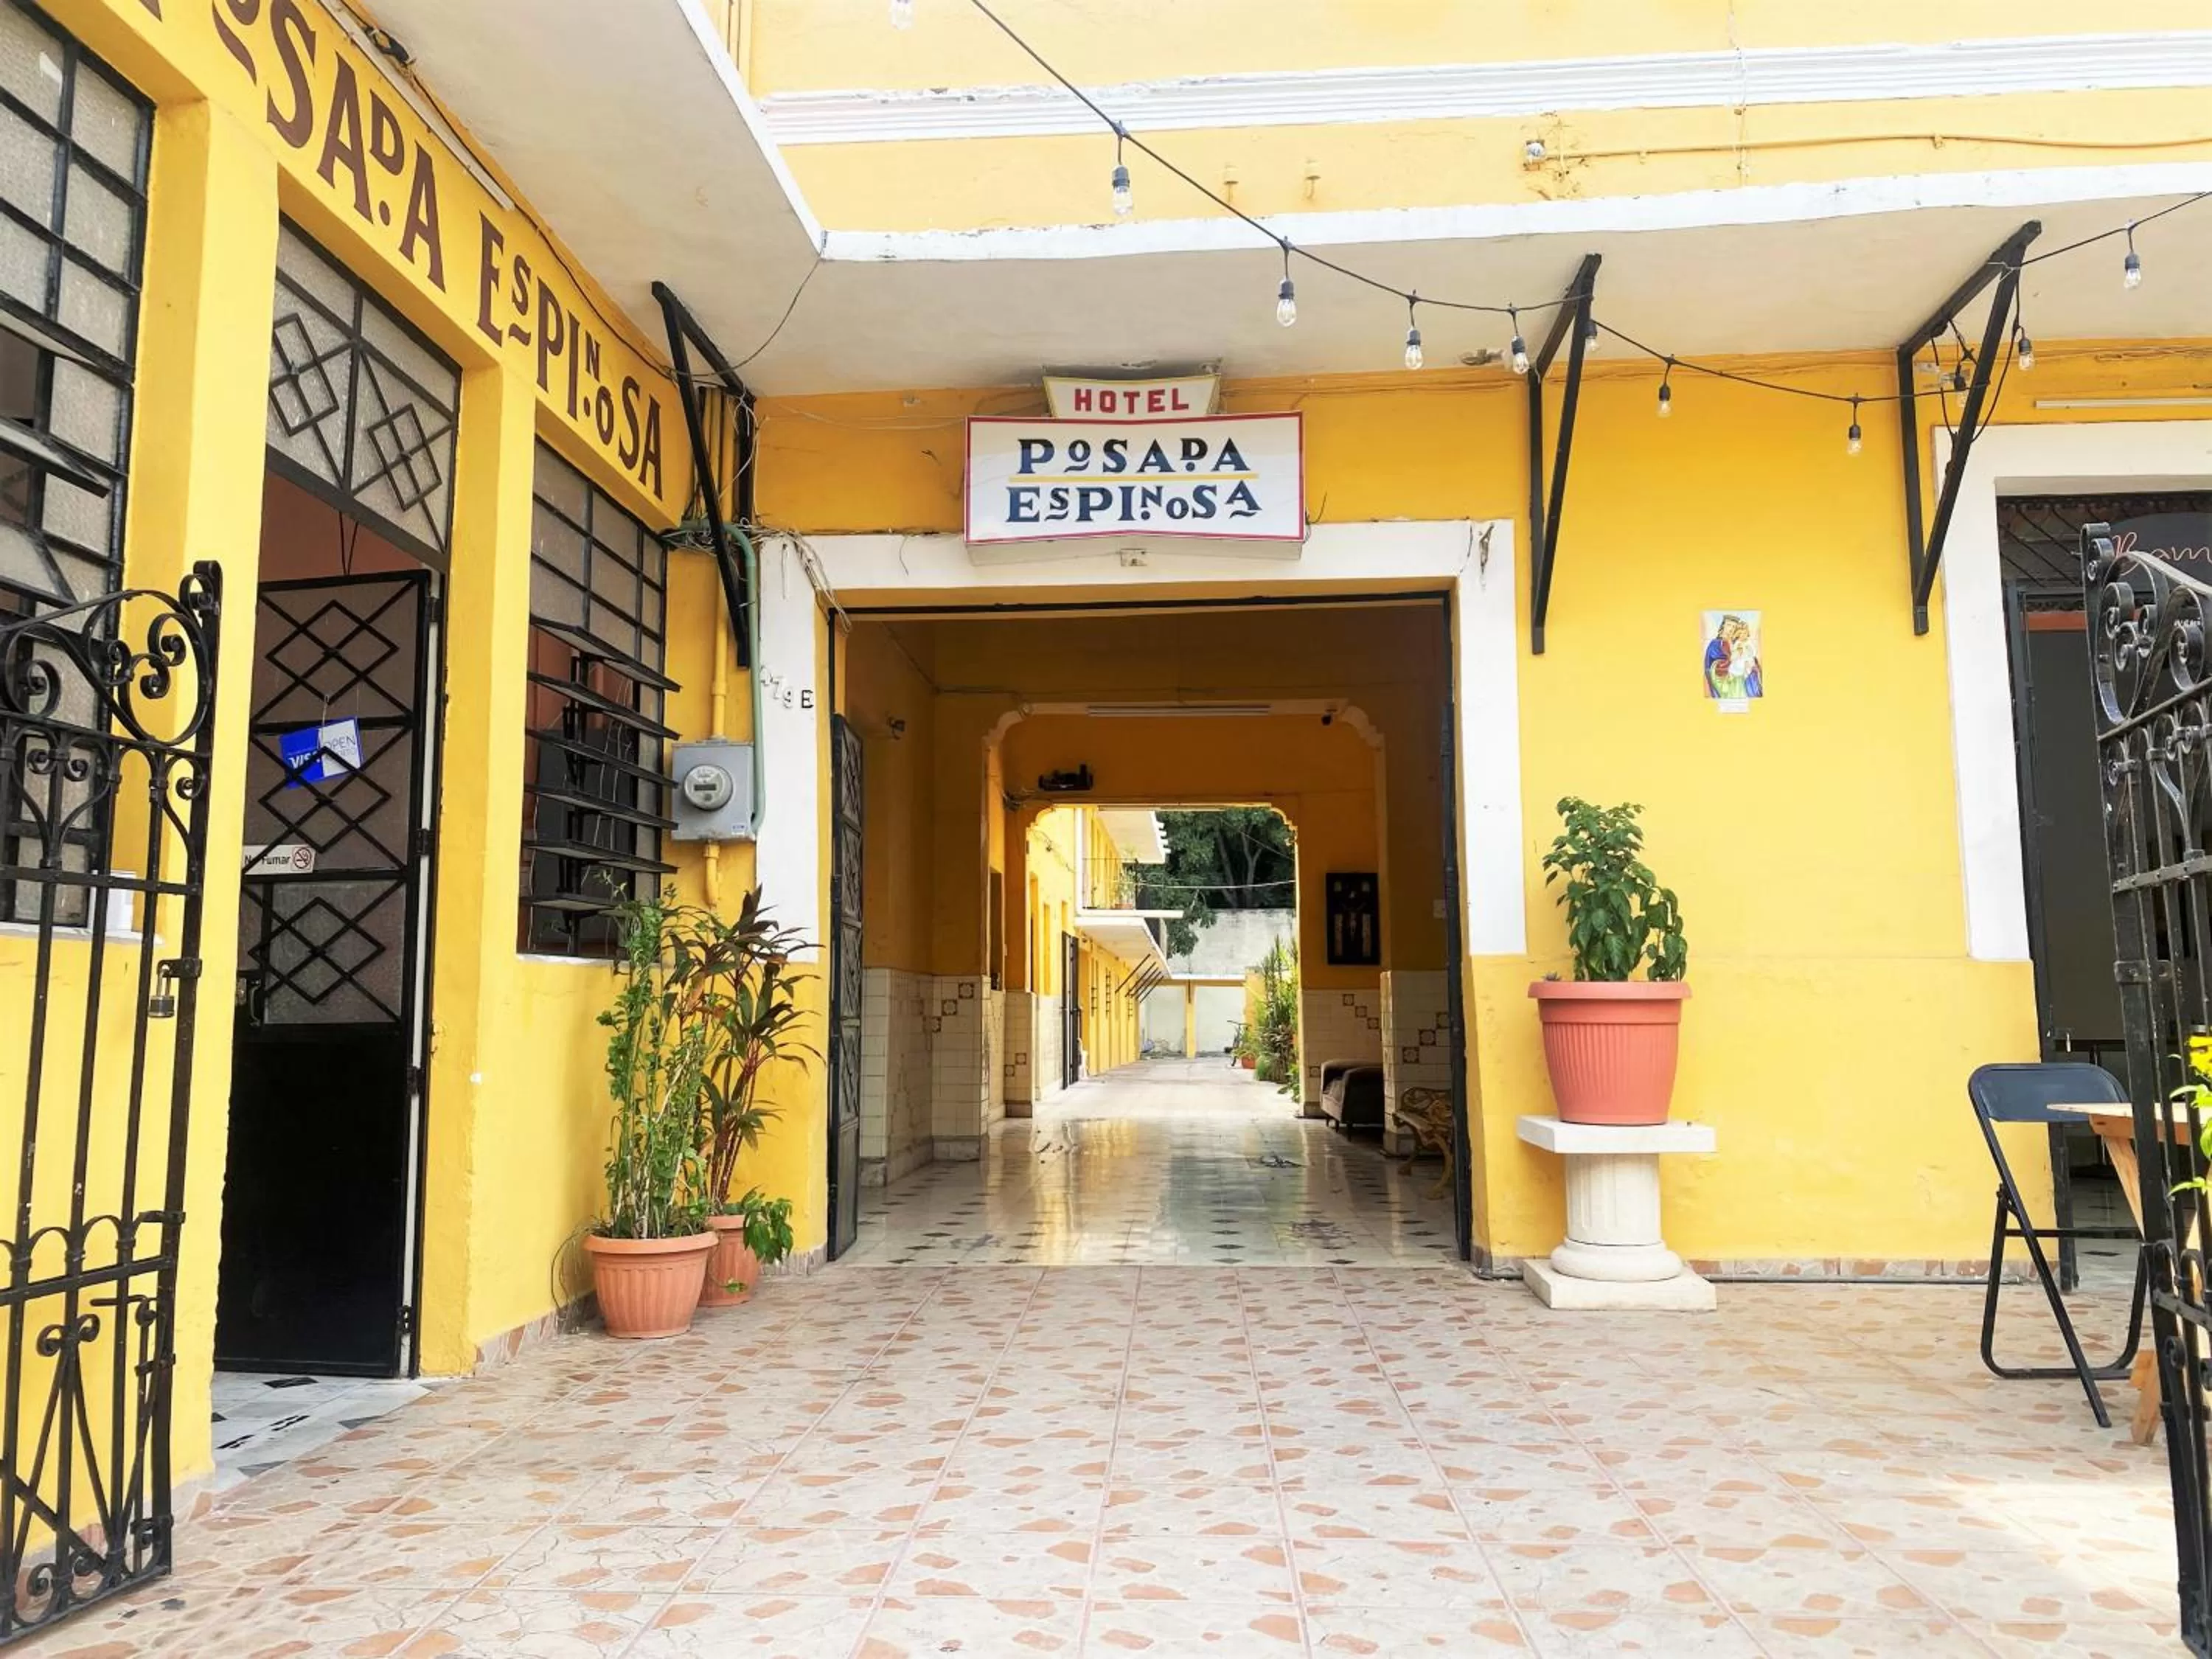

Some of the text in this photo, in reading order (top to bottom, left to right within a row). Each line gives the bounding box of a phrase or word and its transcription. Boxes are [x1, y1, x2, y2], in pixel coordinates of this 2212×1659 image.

[477, 209, 663, 501] ESPINOSA
[1074, 388, 1189, 414] HOTEL
[1017, 437, 1251, 474] POSADA
[1005, 479, 1262, 523] ESPINOSA
[801, 689, 814, 709] E
